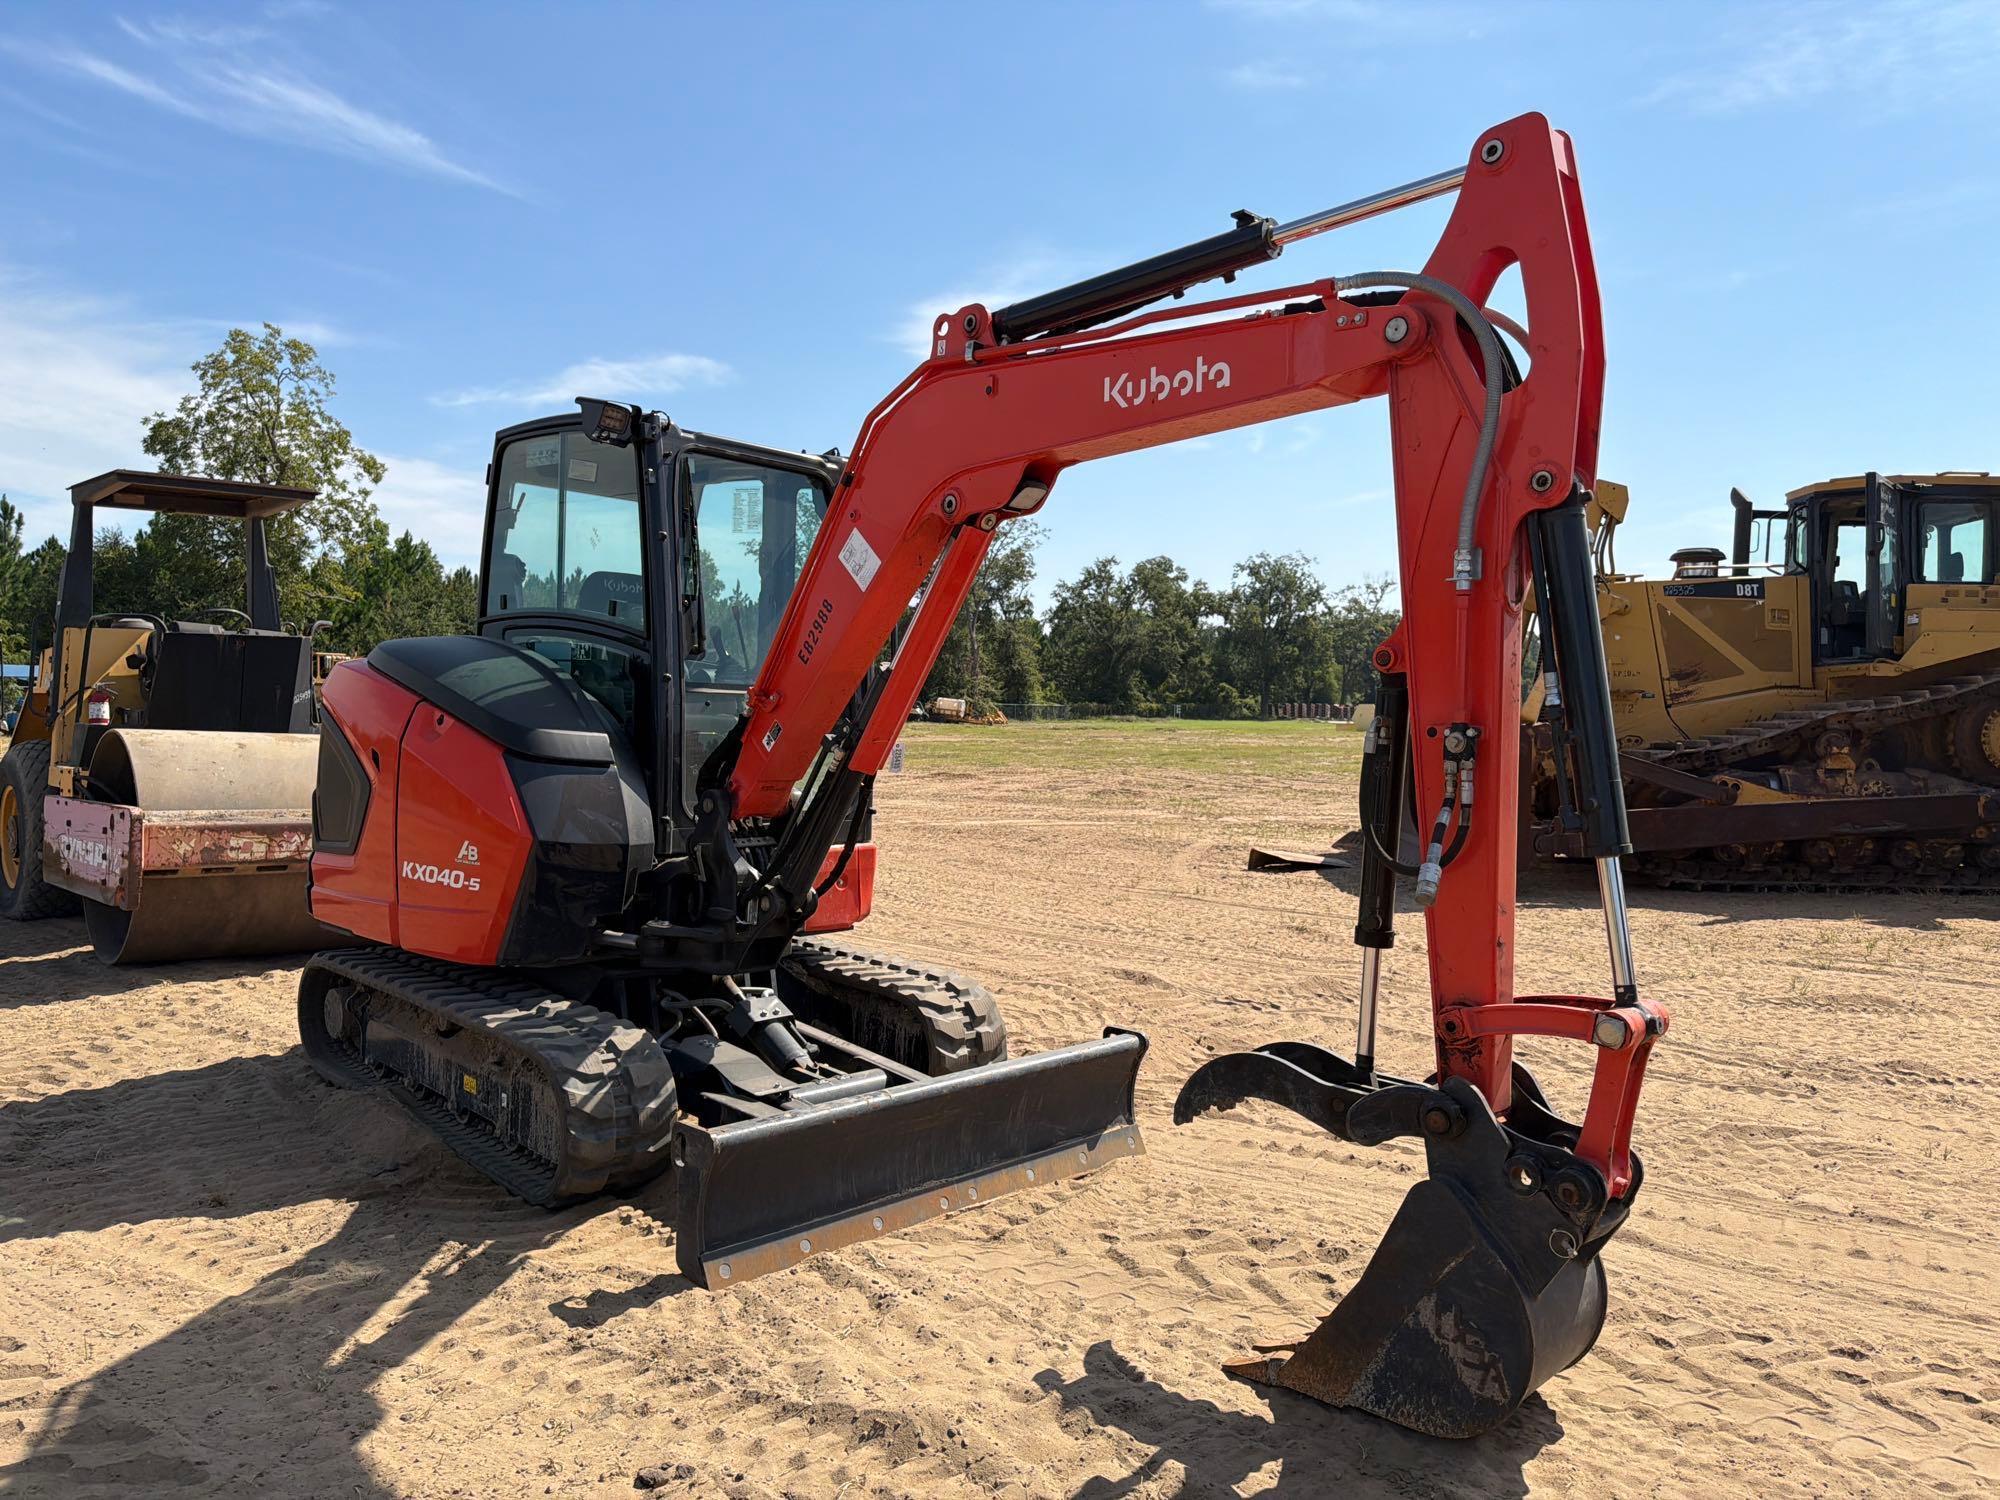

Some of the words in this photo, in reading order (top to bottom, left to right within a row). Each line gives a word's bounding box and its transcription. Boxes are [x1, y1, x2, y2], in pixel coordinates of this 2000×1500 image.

[1103, 355, 1231, 408] Kubota
[1735, 583, 1760, 597] D8T
[402, 860, 481, 891] KX040-5
